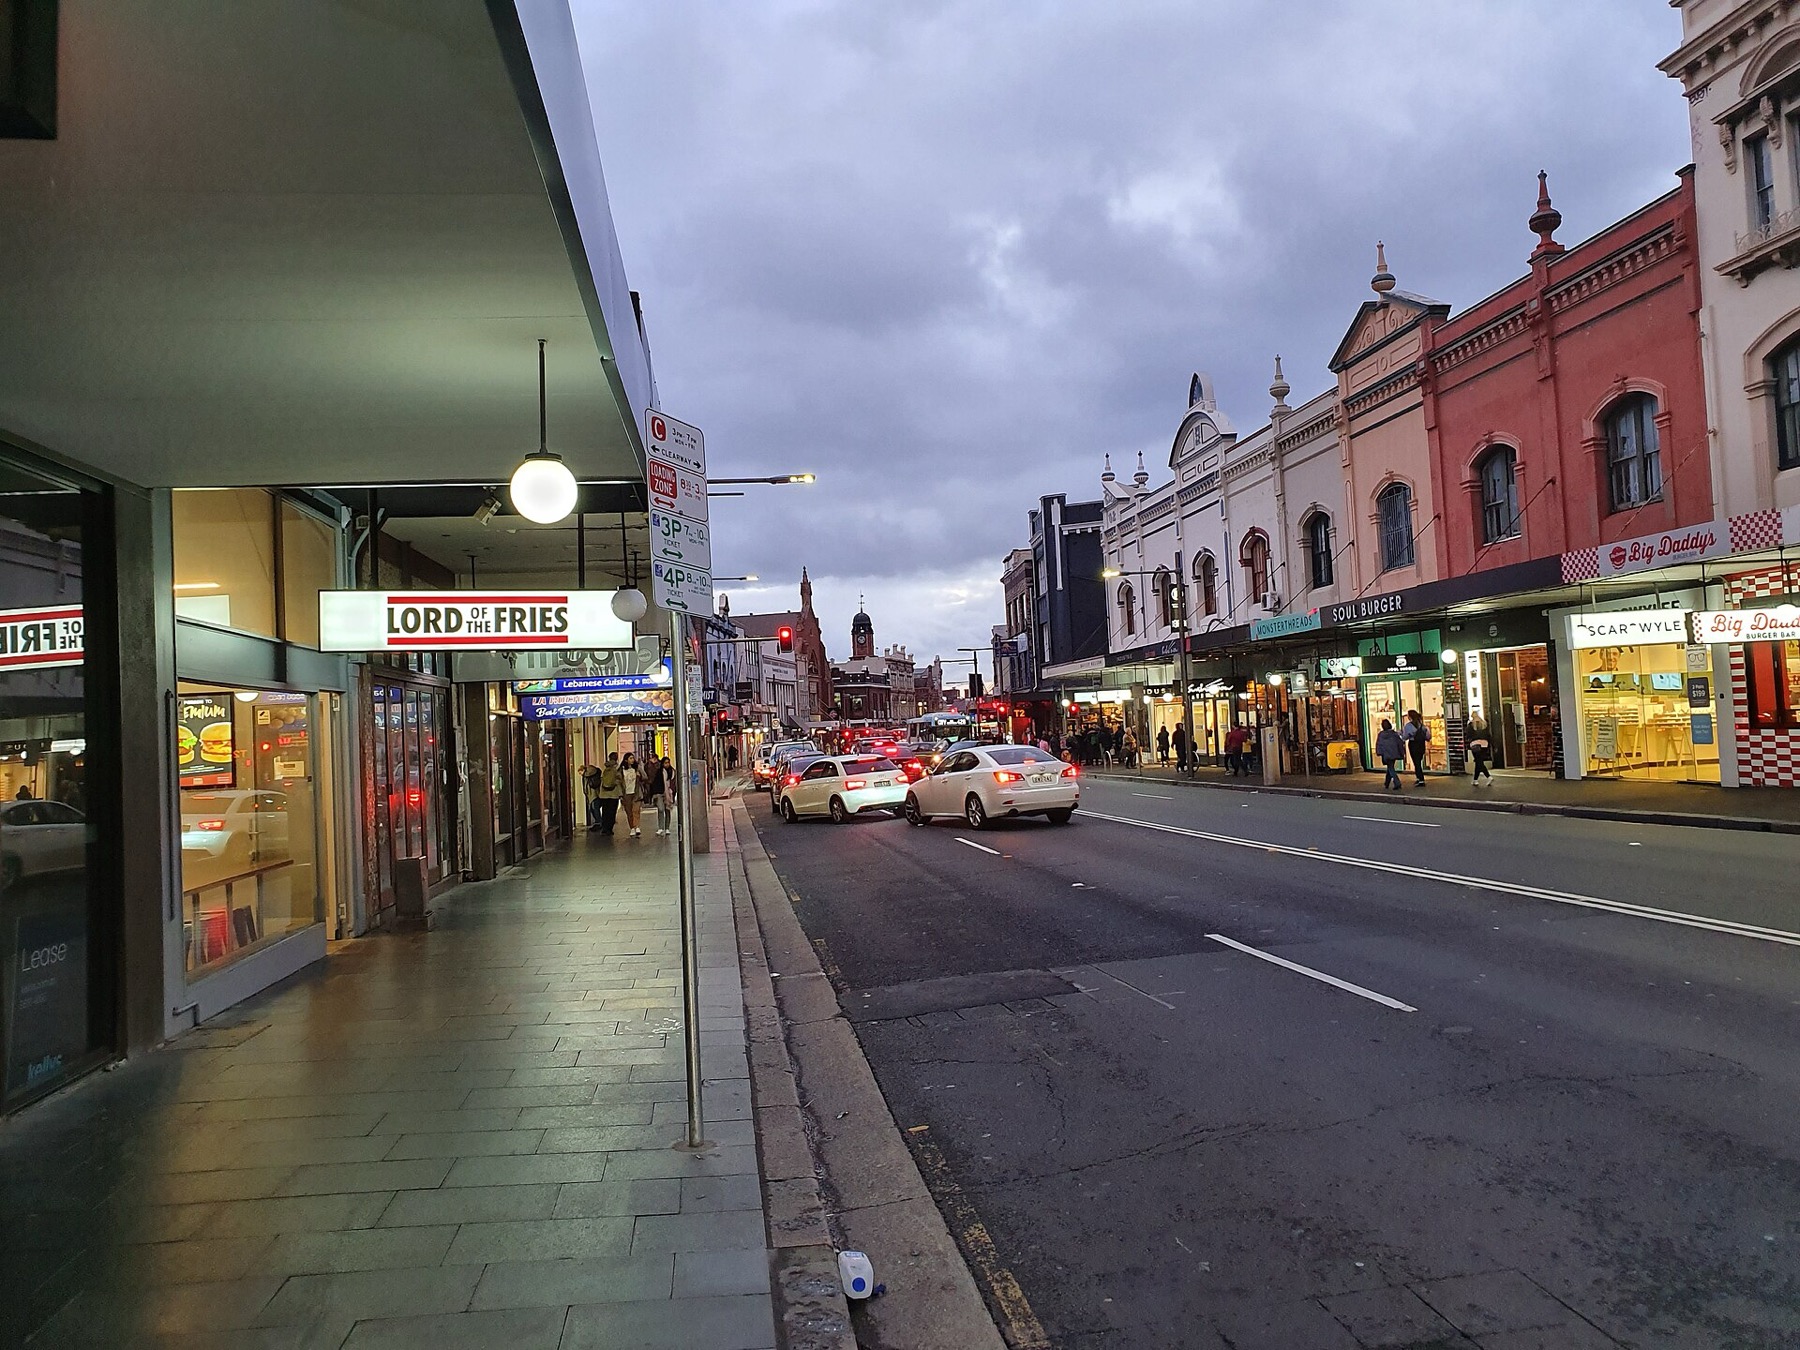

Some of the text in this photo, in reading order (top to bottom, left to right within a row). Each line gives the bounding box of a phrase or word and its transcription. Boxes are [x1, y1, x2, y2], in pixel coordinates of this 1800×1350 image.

[655, 419, 664, 439] C
[661, 448, 692, 465] CLEARWAY
[650, 462, 676, 483] LOADING
[654, 478, 674, 496] ZONE
[661, 516, 682, 538] 3P
[663, 537, 681, 548] TICKET
[1628, 528, 1718, 565] Big Daddy's
[663, 567, 685, 588] 4P
[666, 588, 684, 598] TICKET
[470, 606, 488, 620] OF
[1332, 594, 1403, 623] SOUL BURGER
[387, 607, 463, 634] LORD
[466, 621, 492, 633] THE
[494, 606, 569, 633] FRIES
[1257, 614, 1313, 636] MONSTERTHREADS
[1710, 613, 1743, 638] Big
[1745, 630, 1796, 640] BURGER BAR
[563, 679, 602, 688] Lebanese
[603, 678, 633, 687] Cuisine
[536, 707, 557, 718] Best
[558, 705, 591, 718] Falafel
[604, 703, 634, 715] Sydney
[1013, 709, 1026, 718] T2
[22, 943, 67, 972] Lease
